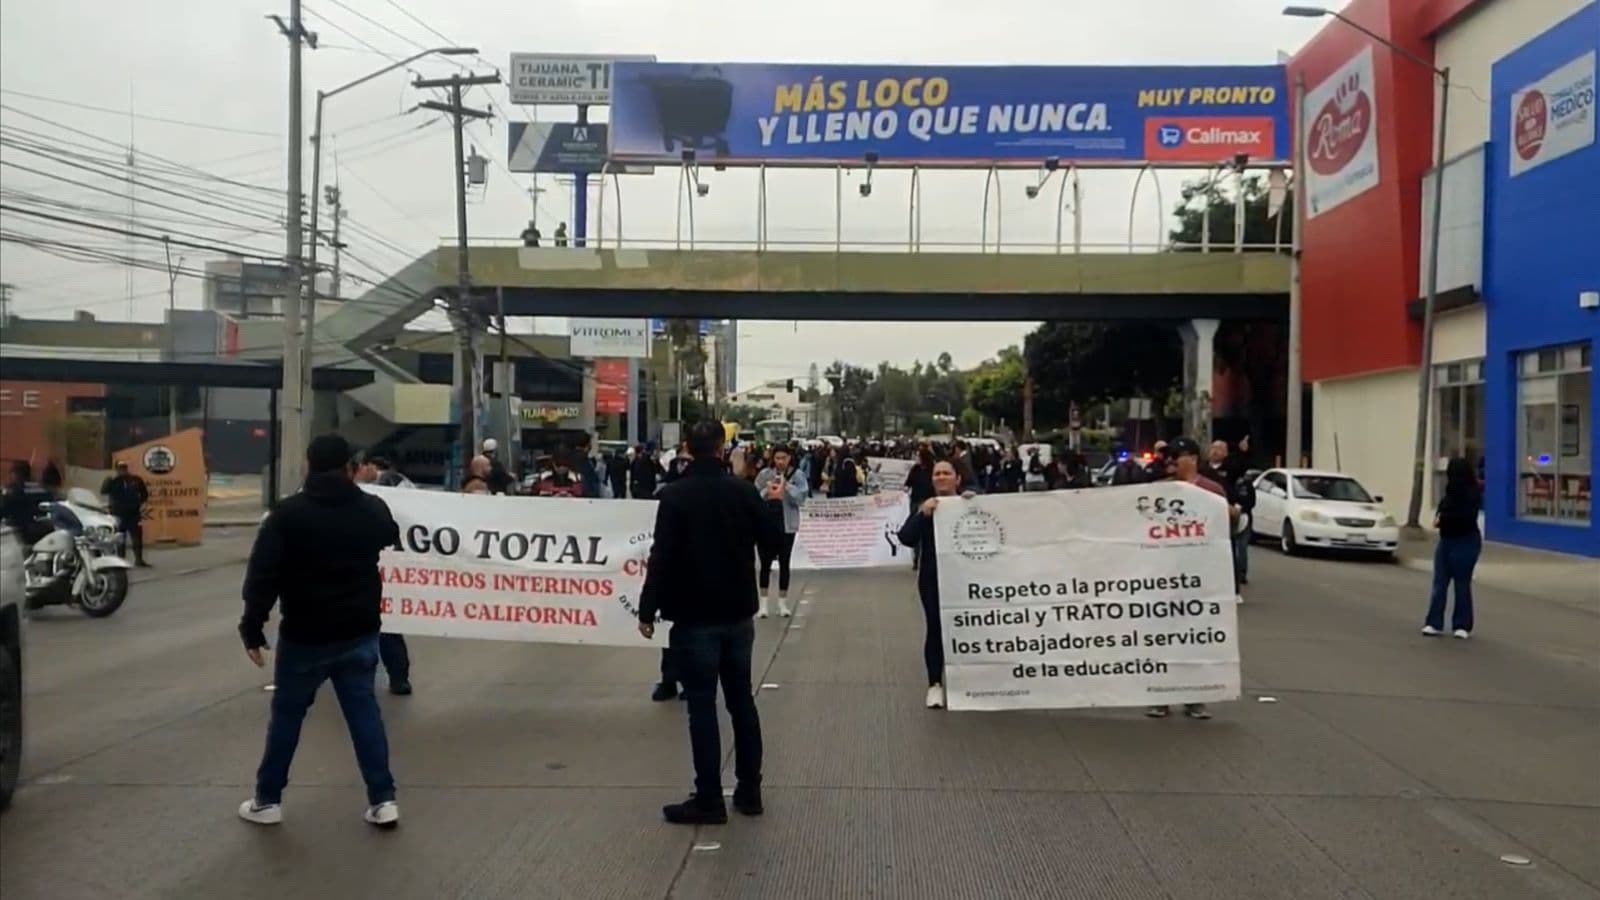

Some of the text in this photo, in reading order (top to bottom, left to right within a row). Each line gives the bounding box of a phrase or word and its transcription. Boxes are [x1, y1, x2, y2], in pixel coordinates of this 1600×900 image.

[518, 76, 586, 88] CERAMIC
[519, 63, 580, 75] TIJUANA
[774, 75, 949, 112] MÁS LOCO
[1138, 86, 1276, 108] MUY PRONTO
[758, 117, 778, 145] Y
[786, 108, 898, 144] LLENO
[908, 106, 978, 141] QUE
[1186, 126, 1261, 145] Calimax
[1312, 108, 1362, 161] Roma
[1148, 521, 1206, 540] CNTE
[474, 529, 609, 566] TOTAL
[493, 573, 614, 596] INTERINOS
[968, 572, 1202, 602] Respeto a la propuesta
[401, 597, 457, 618] BAJA
[463, 601, 599, 627] CALIFORNIA
[953, 599, 1221, 628] sindical y TRATO DIGNO a
[951, 626, 1227, 656] los trabajadores al servicio
[1012, 657, 1168, 679] de la educación
